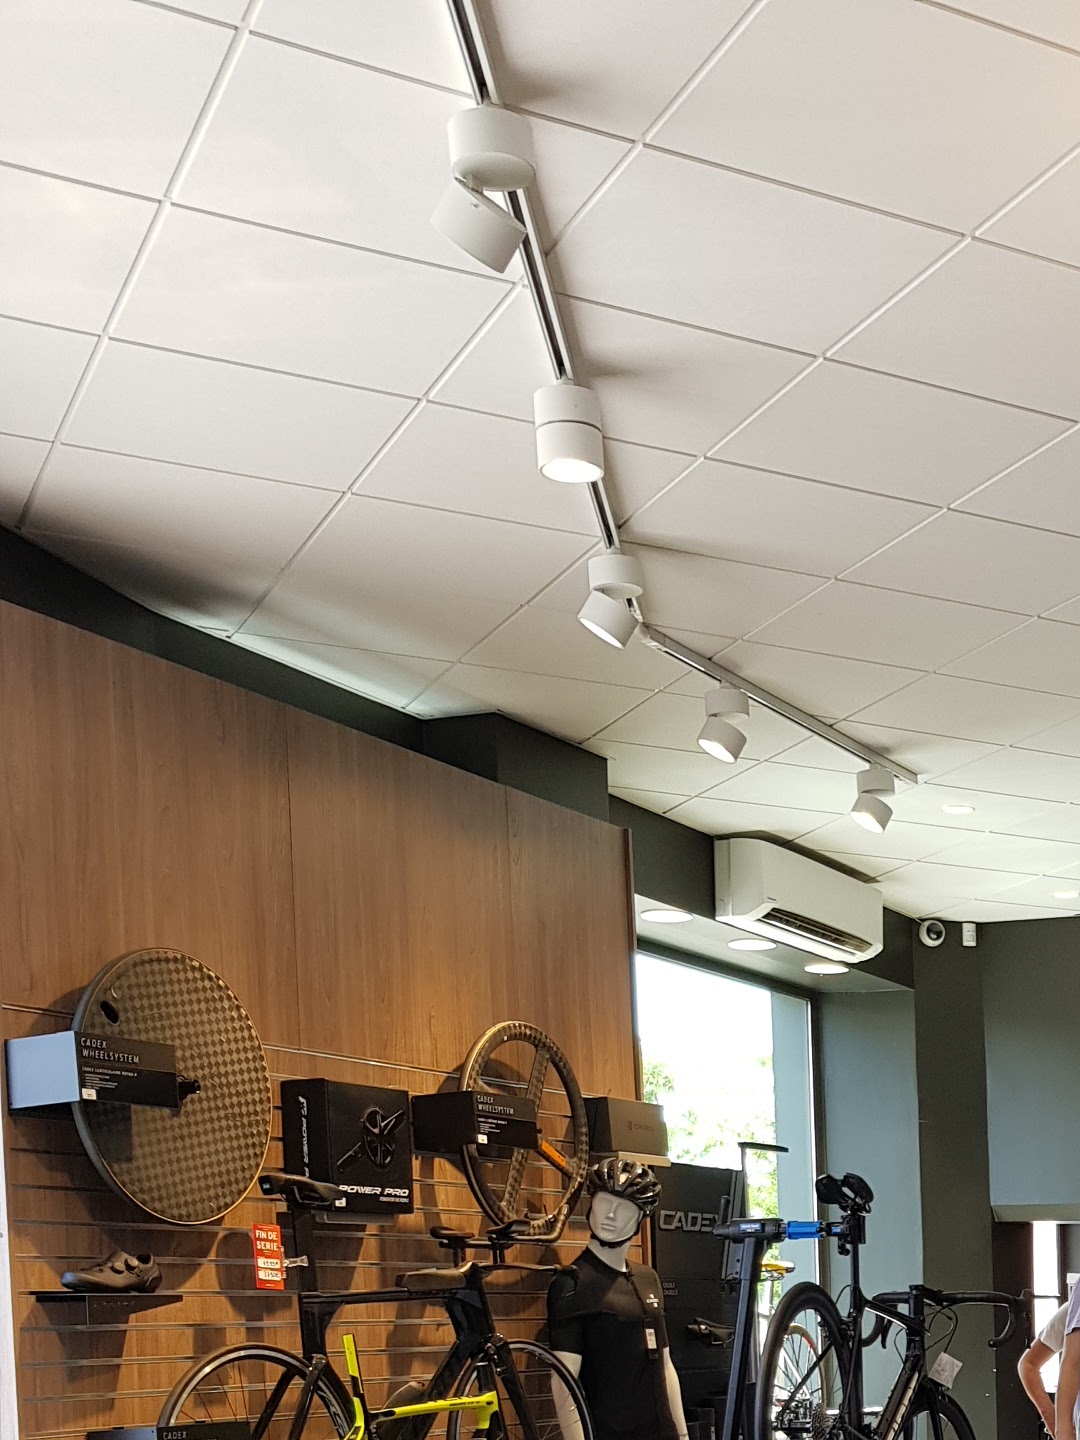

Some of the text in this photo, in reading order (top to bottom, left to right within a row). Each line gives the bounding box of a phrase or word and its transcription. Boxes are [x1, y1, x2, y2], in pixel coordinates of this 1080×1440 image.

[80, 1037, 107, 1049] CADEX
[82, 1048, 140, 1064] WHEELSYSTEM
[339, 1185, 410, 1197] POWER PRO
[255, 1229, 278, 1240] FIN DE
[256, 1240, 279, 1251] SERIE
[162, 1431, 187, 1440] CADEX
